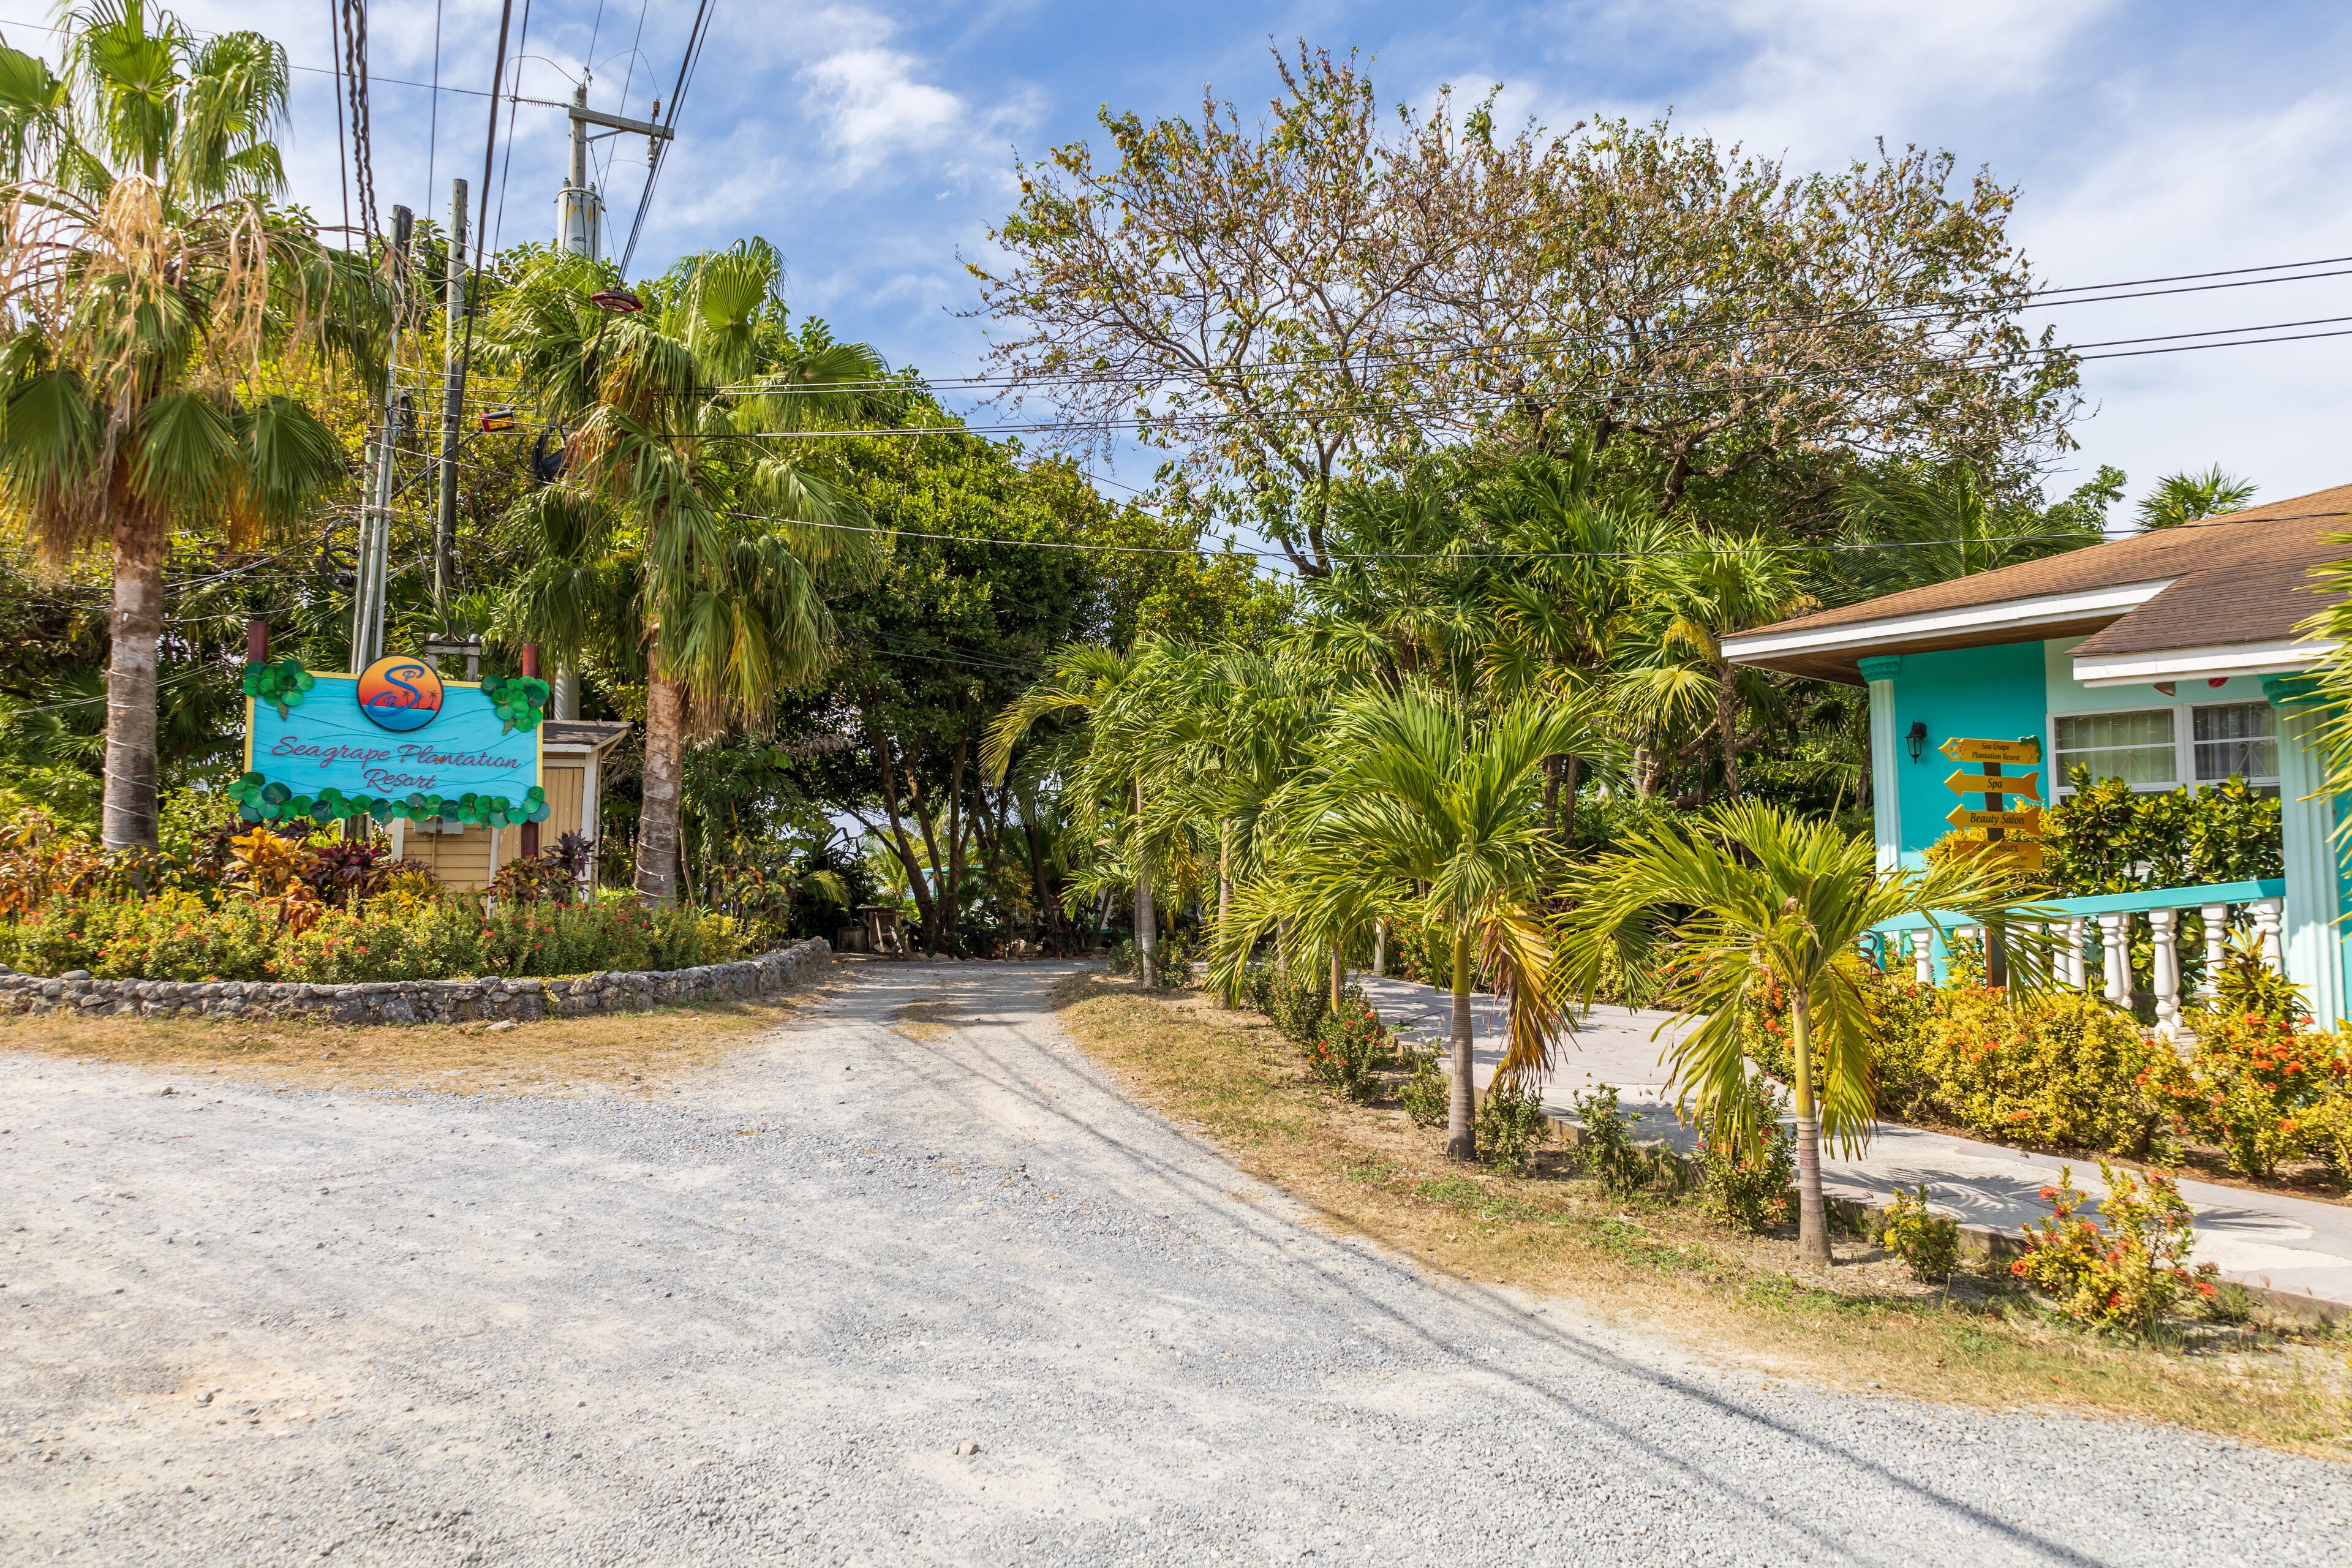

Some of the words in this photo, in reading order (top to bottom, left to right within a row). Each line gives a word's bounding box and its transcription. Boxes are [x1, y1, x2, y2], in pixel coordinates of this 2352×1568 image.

[271, 736, 390, 769] Seagrape
[397, 744, 521, 768] Plantation
[1993, 743, 2010, 752] Grape
[364, 768, 436, 793] Resort
[1987, 778, 2003, 790] Spa
[1970, 813, 1999, 826] Beauty
[2001, 814, 2025, 824] Salon
